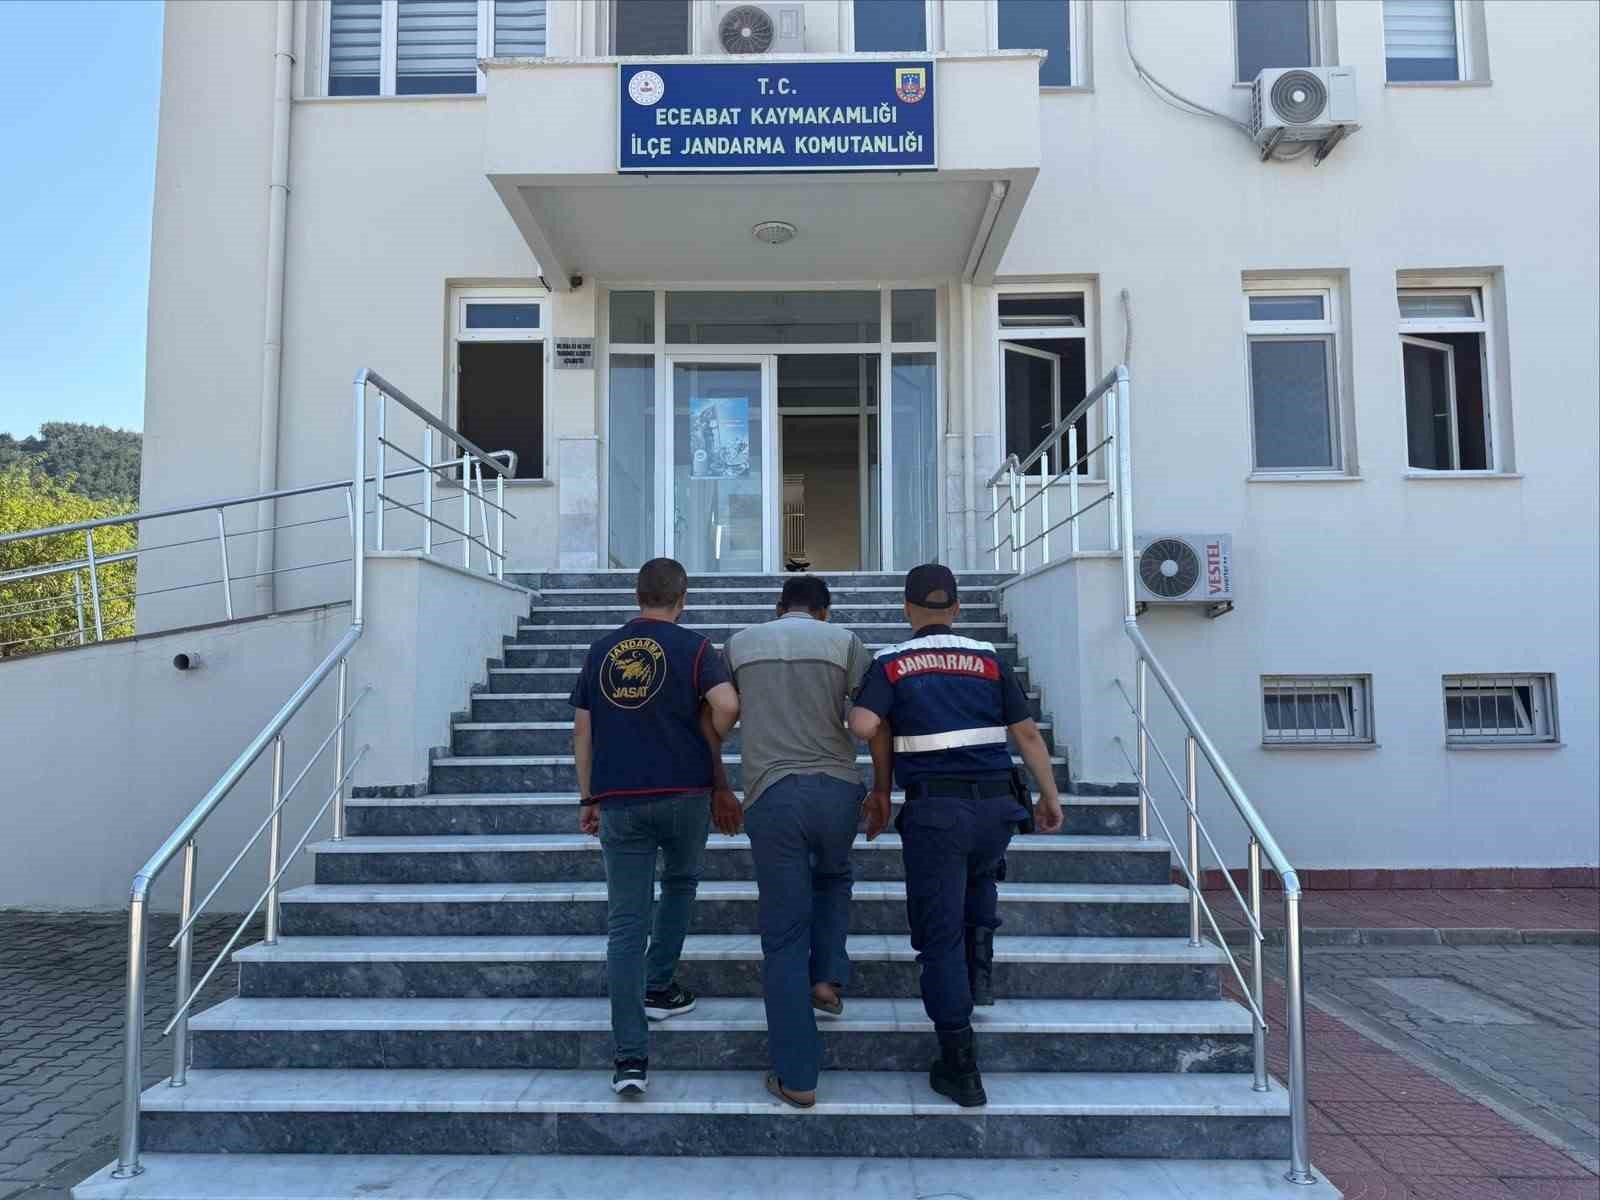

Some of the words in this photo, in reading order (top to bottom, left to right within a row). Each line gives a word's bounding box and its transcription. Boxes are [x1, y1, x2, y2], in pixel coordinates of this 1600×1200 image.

[655, 107, 741, 126] ECEABAT
[751, 102, 897, 125] KAYMAKAMLIĞI
[631, 133, 672, 159] İLÇE
[680, 136, 785, 155] JANDARMA
[795, 130, 923, 153] KOMUTANLIĞI
[1206, 542, 1222, 594] VESTEL
[608, 639, 662, 661] JANDARMA
[897, 654, 985, 675] JANDARMA
[613, 687, 648, 698] JASAT
